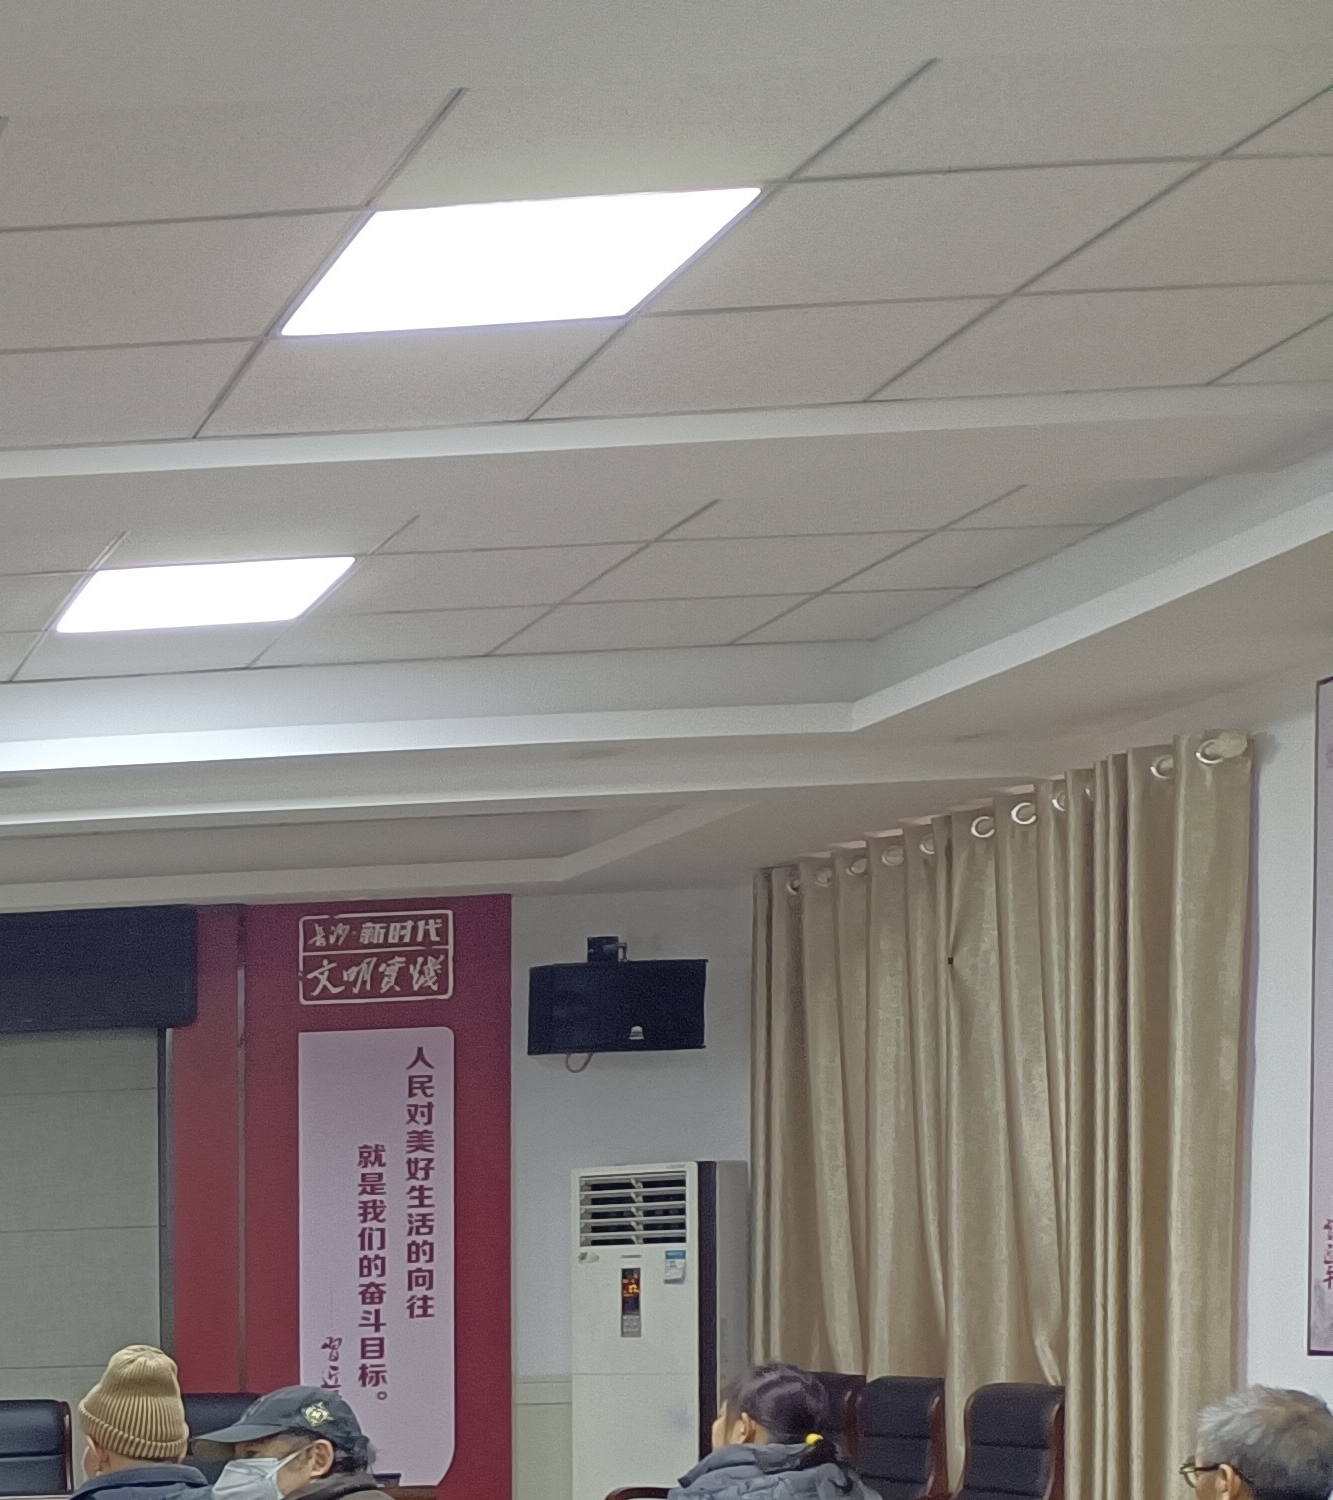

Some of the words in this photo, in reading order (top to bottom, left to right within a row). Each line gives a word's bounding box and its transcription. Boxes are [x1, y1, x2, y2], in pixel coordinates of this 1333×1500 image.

[357, 1144, 388, 1400] 就是我们的奋斗目标。
[405, 1046, 435, 1319] 人民对美好生活的向往
